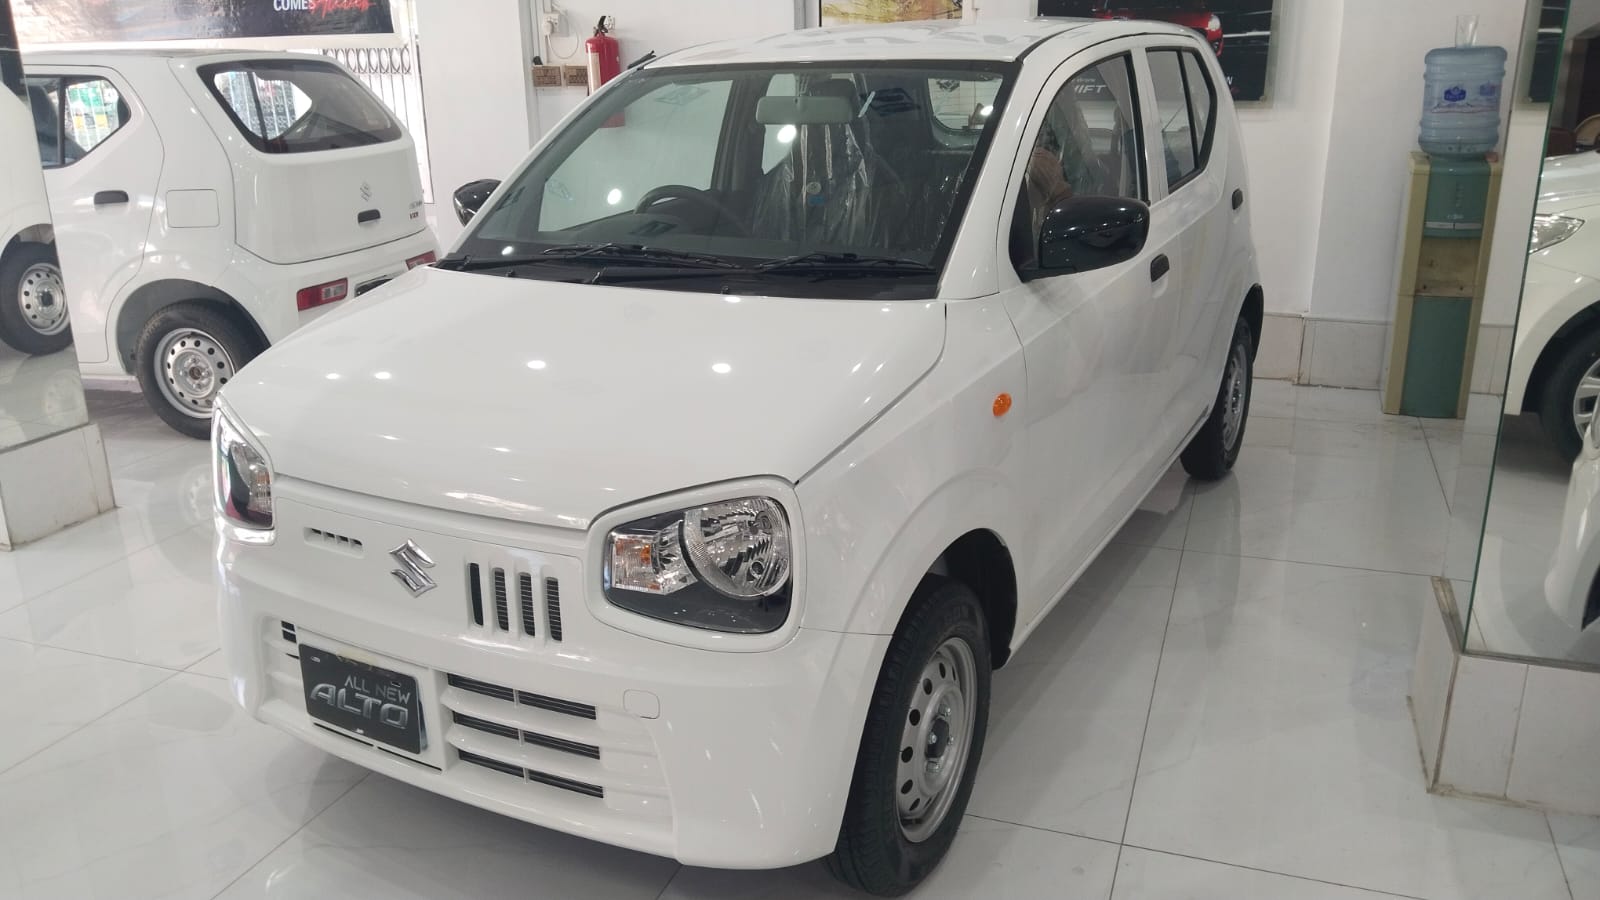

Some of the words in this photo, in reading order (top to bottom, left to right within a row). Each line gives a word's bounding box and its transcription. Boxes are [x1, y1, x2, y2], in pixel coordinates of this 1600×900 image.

[310, 683, 409, 730] ALTO
[344, 675, 371, 693] ALL
[375, 683, 411, 704] NEW
